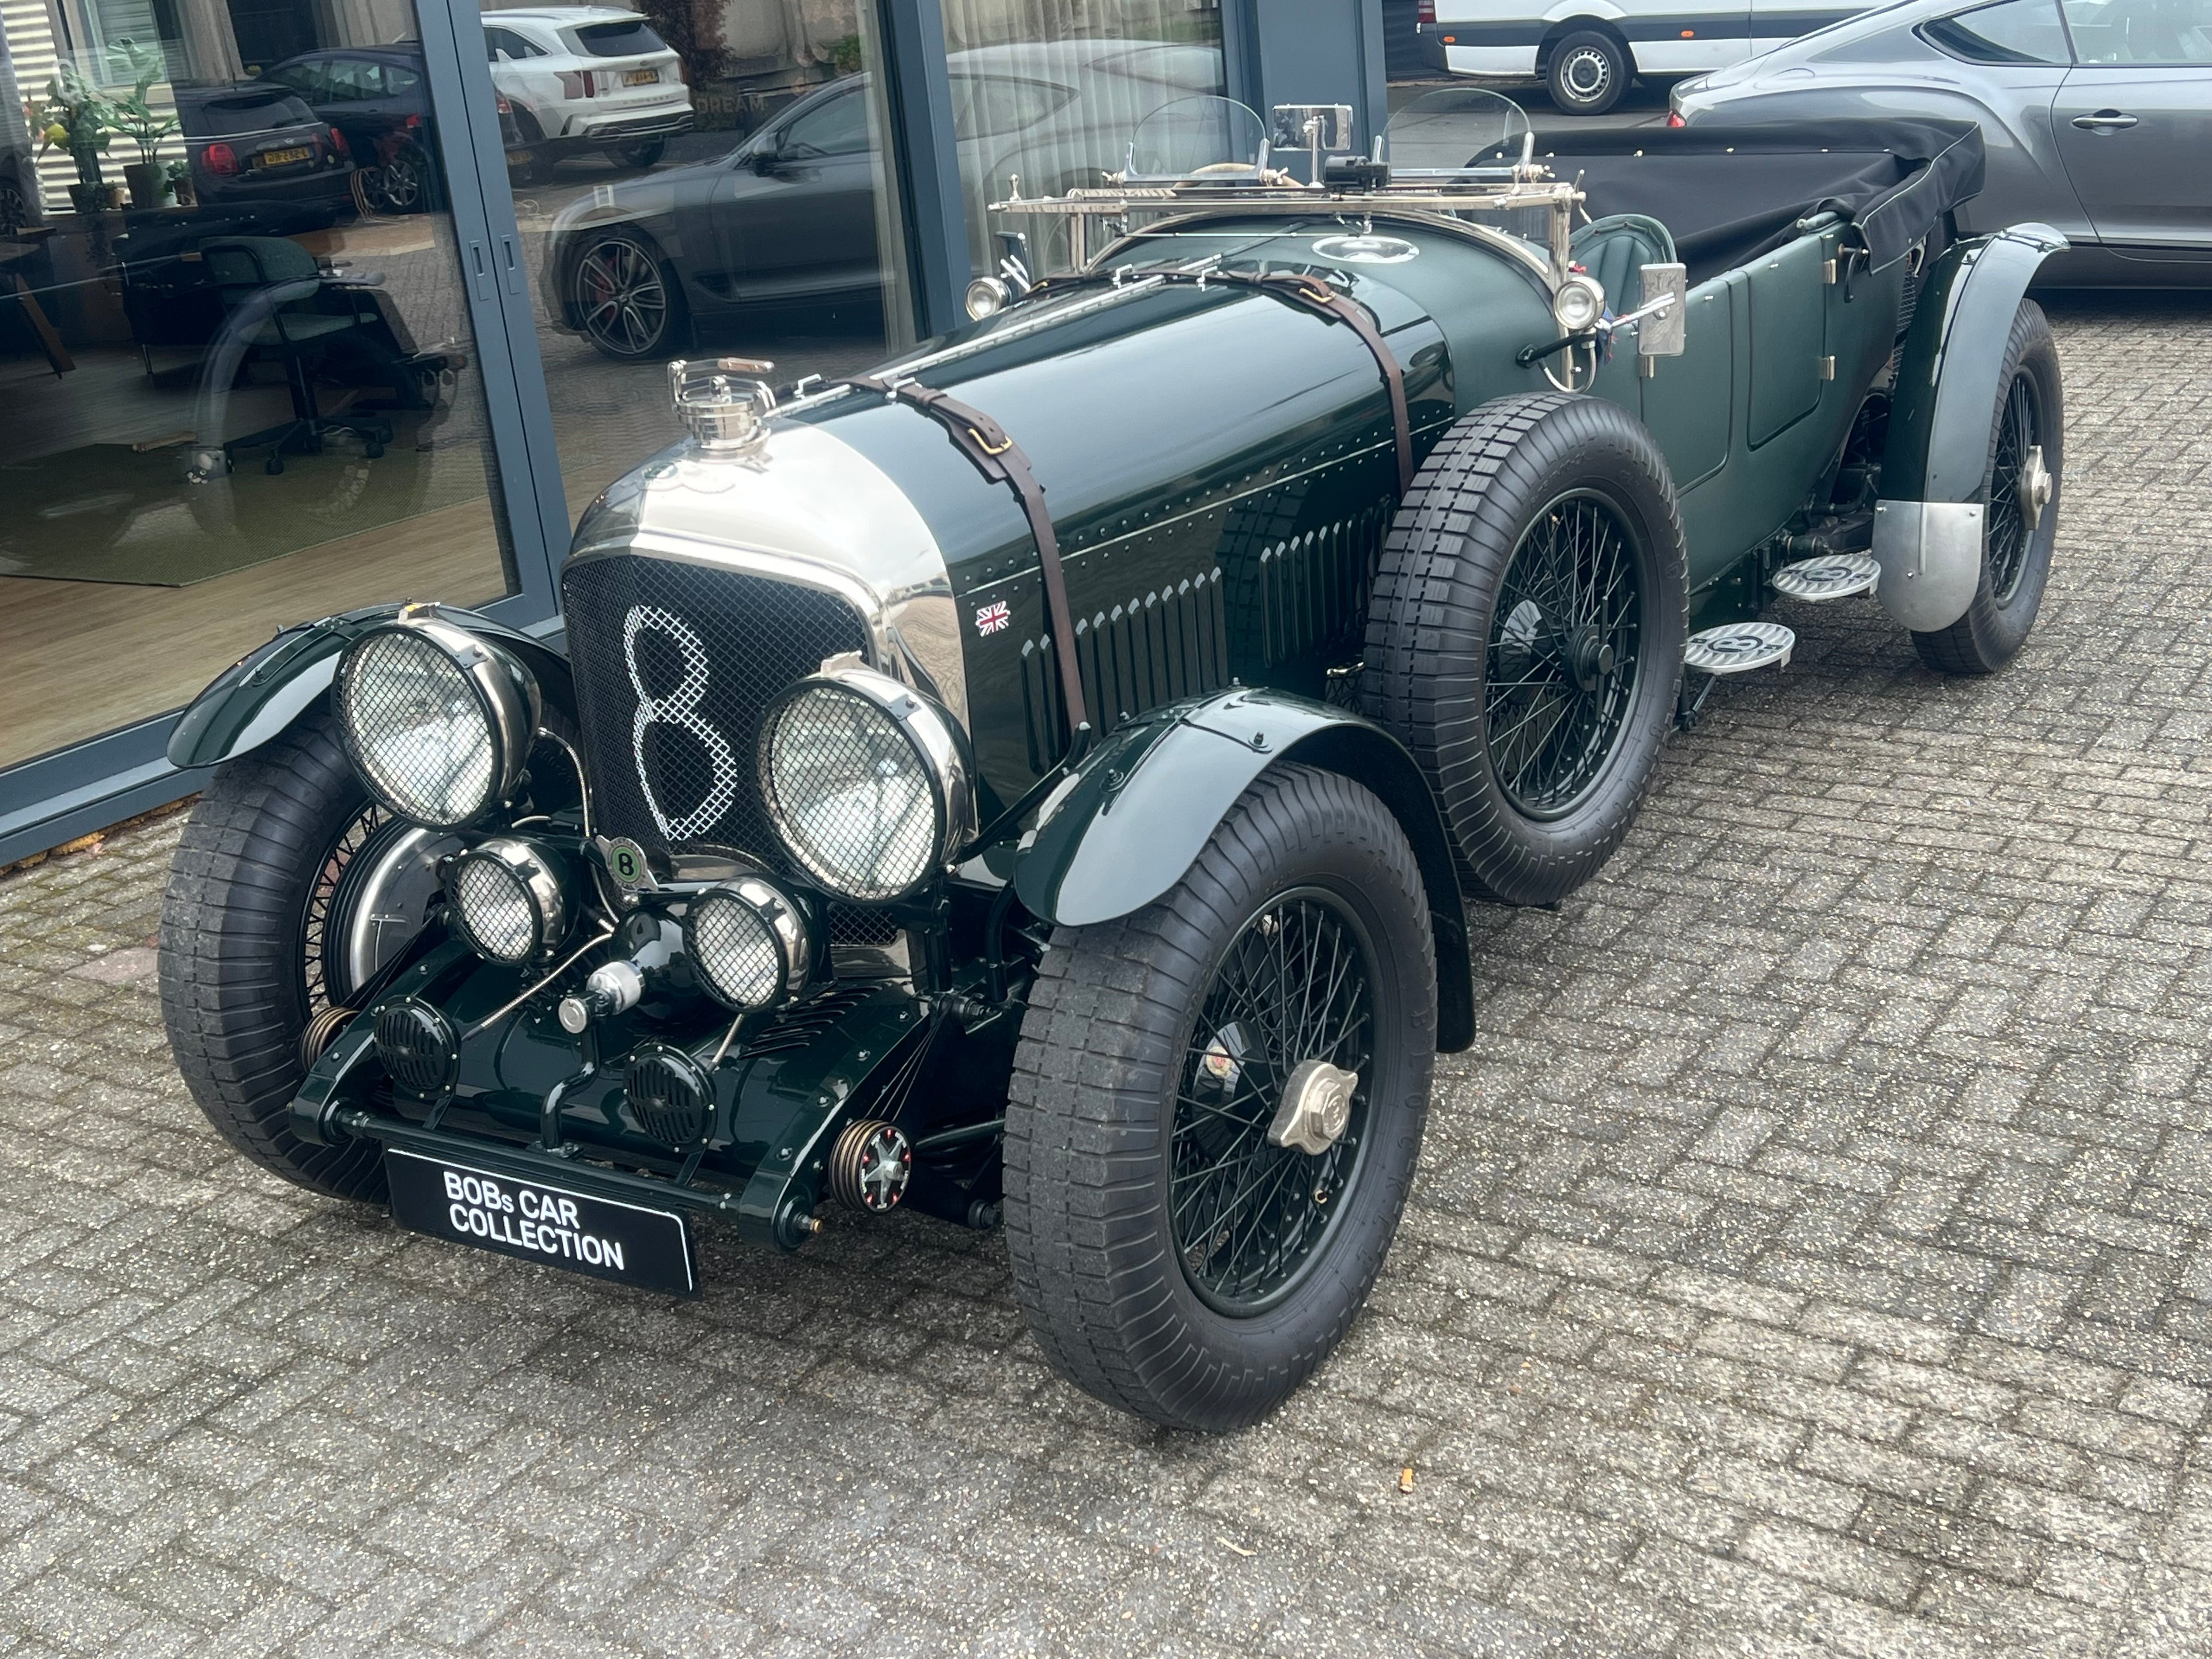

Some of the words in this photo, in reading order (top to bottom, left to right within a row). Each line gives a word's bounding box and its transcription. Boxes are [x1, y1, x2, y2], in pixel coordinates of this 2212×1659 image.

[696, 94, 764, 114] DREAM
[444, 1172, 514, 1213] BOBs
[519, 1190, 580, 1229] CAR
[450, 1203, 624, 1270] COLLECTION
